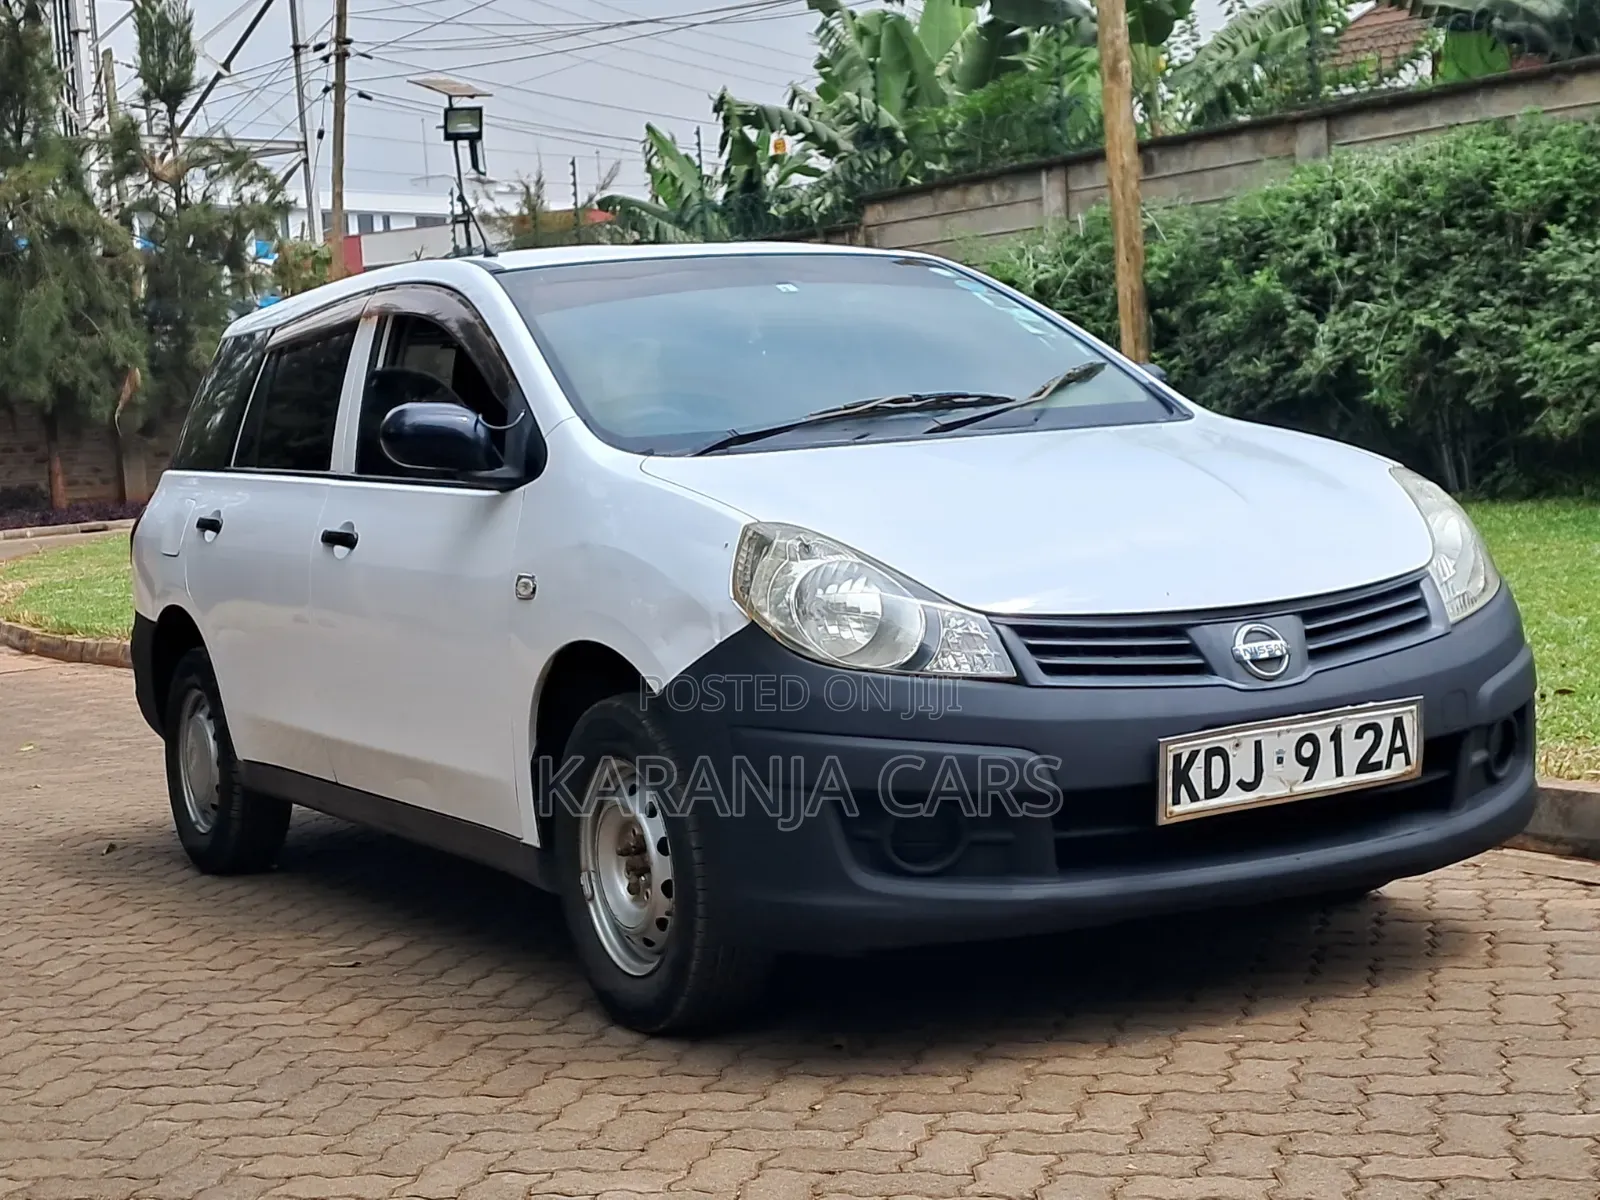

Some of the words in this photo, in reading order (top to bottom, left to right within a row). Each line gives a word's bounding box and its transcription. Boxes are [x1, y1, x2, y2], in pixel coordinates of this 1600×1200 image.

[1242, 642, 1288, 657] NISSAN
[1171, 739, 1264, 806] KDJ
[1294, 716, 1412, 783] 912A
